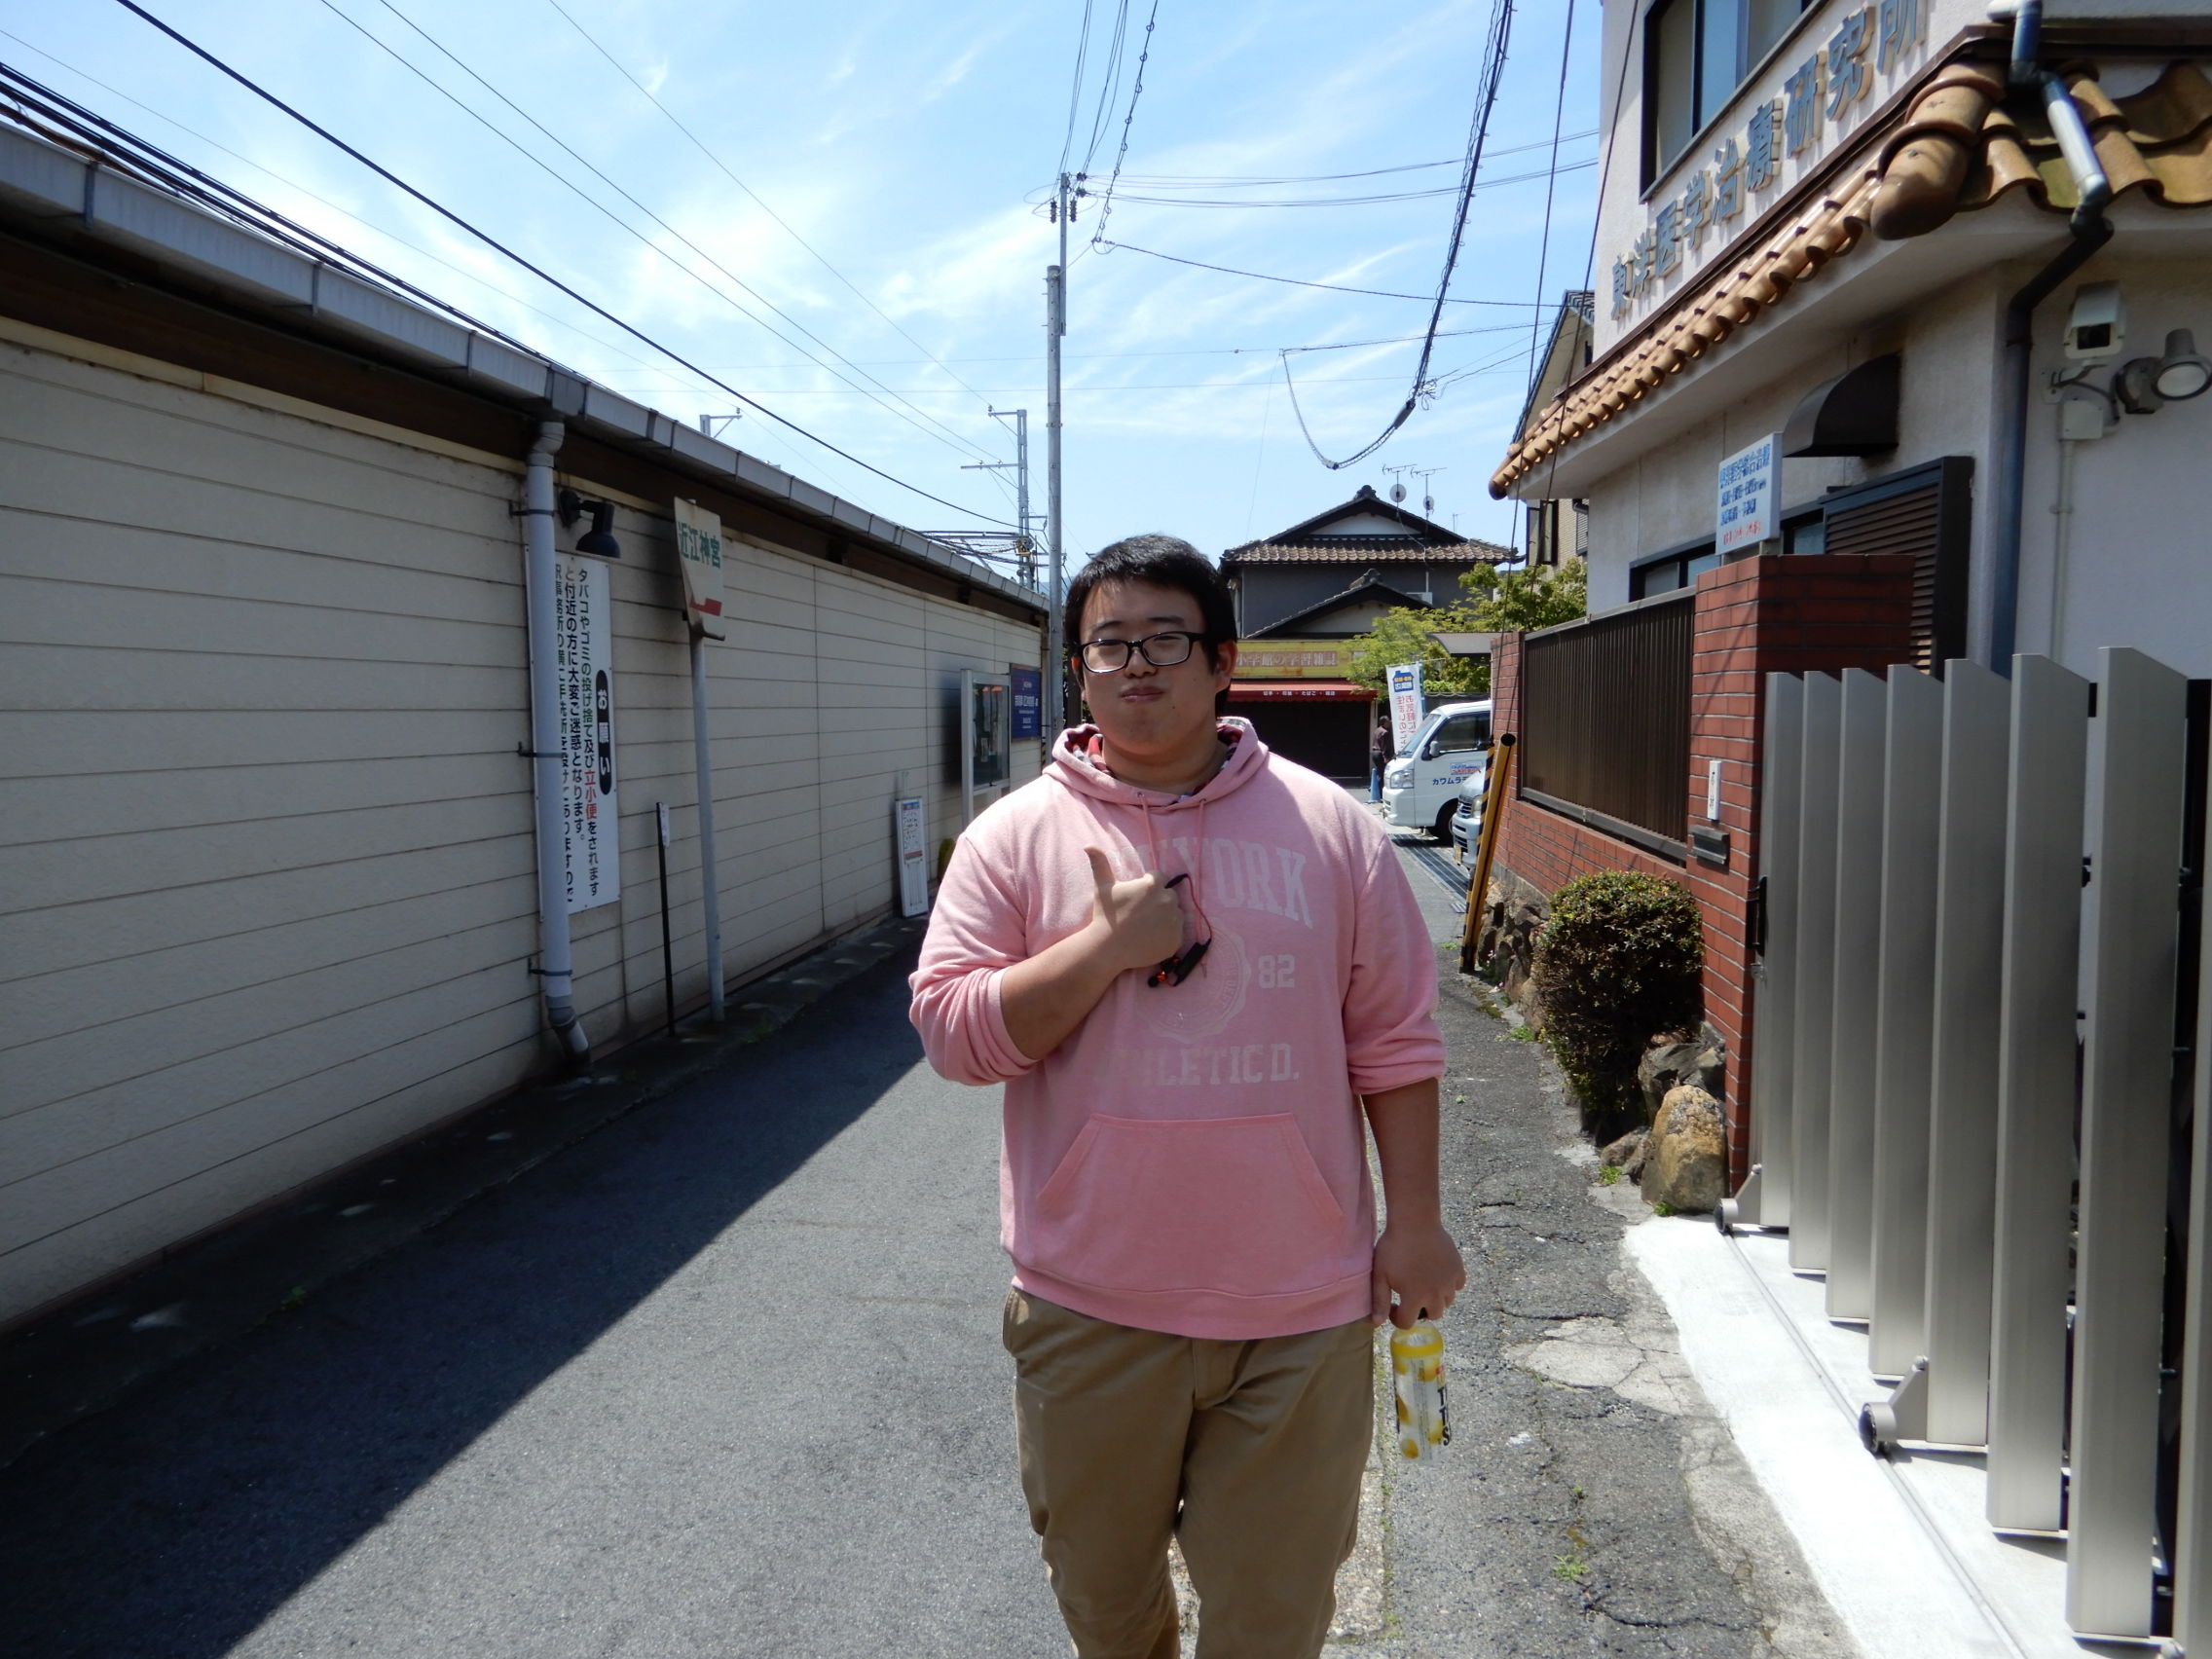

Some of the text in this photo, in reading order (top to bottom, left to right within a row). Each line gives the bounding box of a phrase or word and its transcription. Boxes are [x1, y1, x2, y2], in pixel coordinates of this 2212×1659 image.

[1610, 0, 1927, 321] 東洋医学治療研究所
[678, 522, 720, 569] 近江神宮
[597, 688, 611, 777] お願い
[1258, 954, 1296, 989] 82
